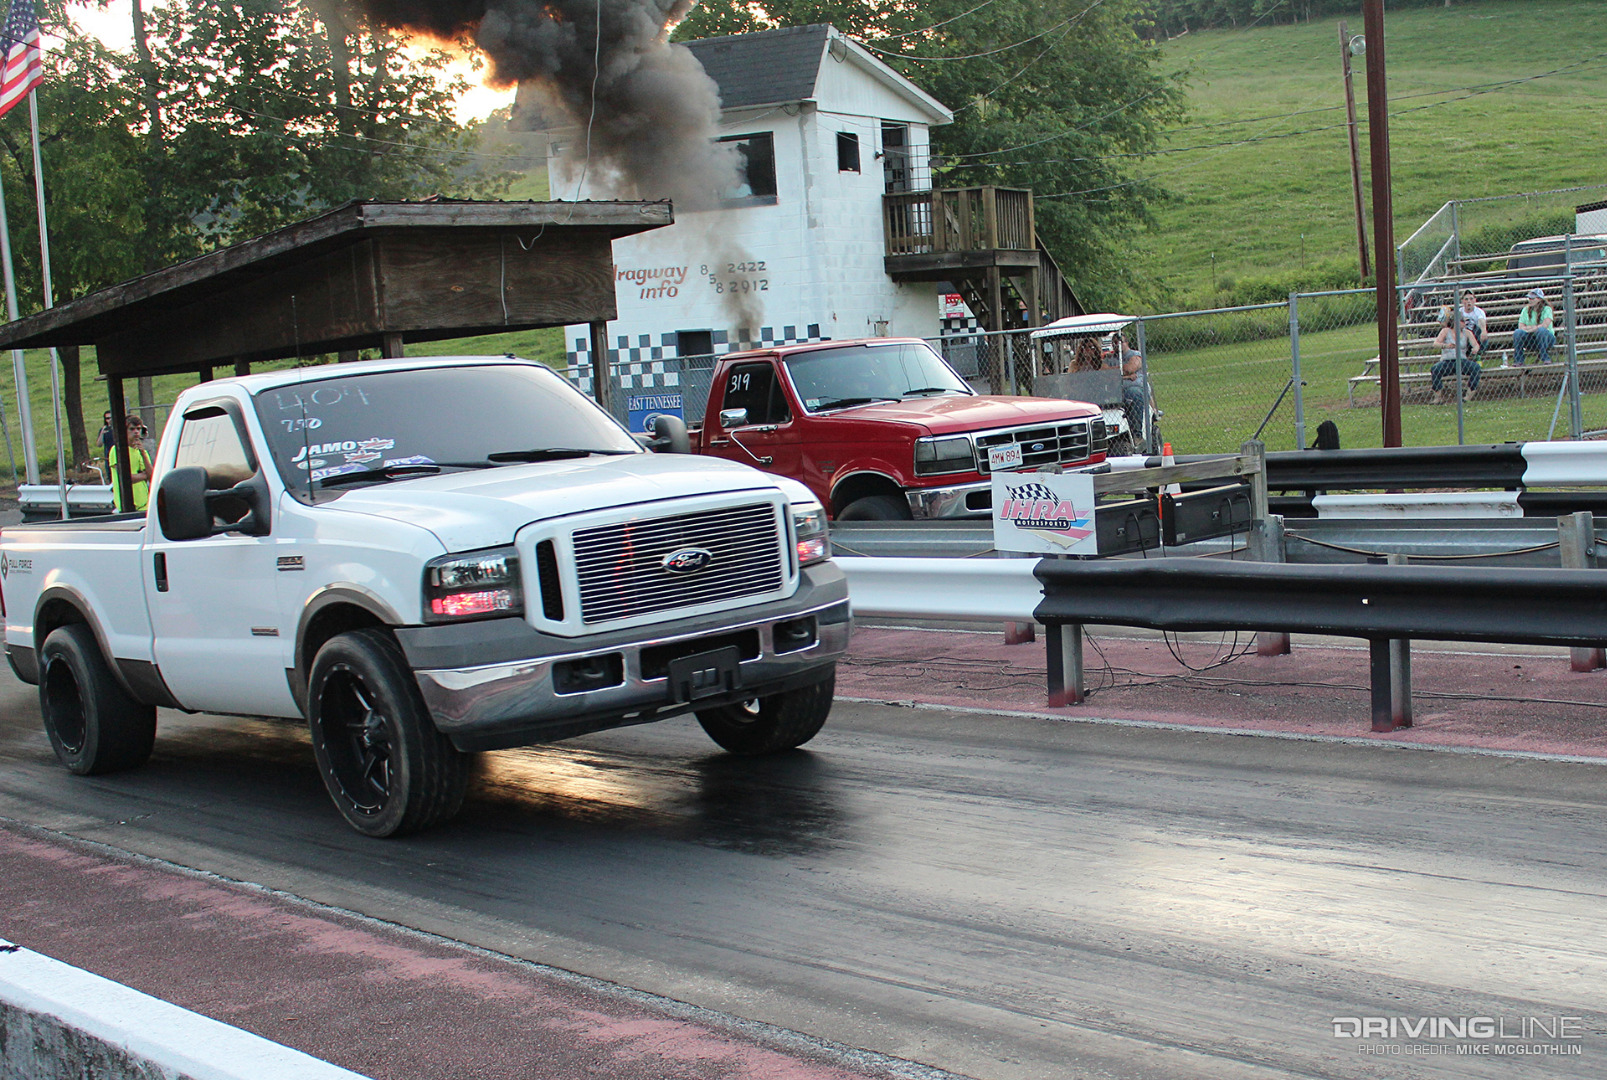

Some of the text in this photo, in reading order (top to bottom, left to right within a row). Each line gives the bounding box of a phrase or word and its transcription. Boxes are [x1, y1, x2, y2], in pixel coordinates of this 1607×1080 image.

[613, 264, 688, 285] ragway
[728, 261, 767, 273] 2422
[640, 279, 678, 299] info
[729, 279, 769, 294] 2912
[729, 373, 751, 393] 319
[628, 394, 682, 411] EAST TENNESSEE
[291, 440, 357, 462] JAMO
[311, 466, 341, 479] ATS
[1000, 499, 1077, 521] IHRA
[1016, 520, 1067, 528] MOTORSPORTS
